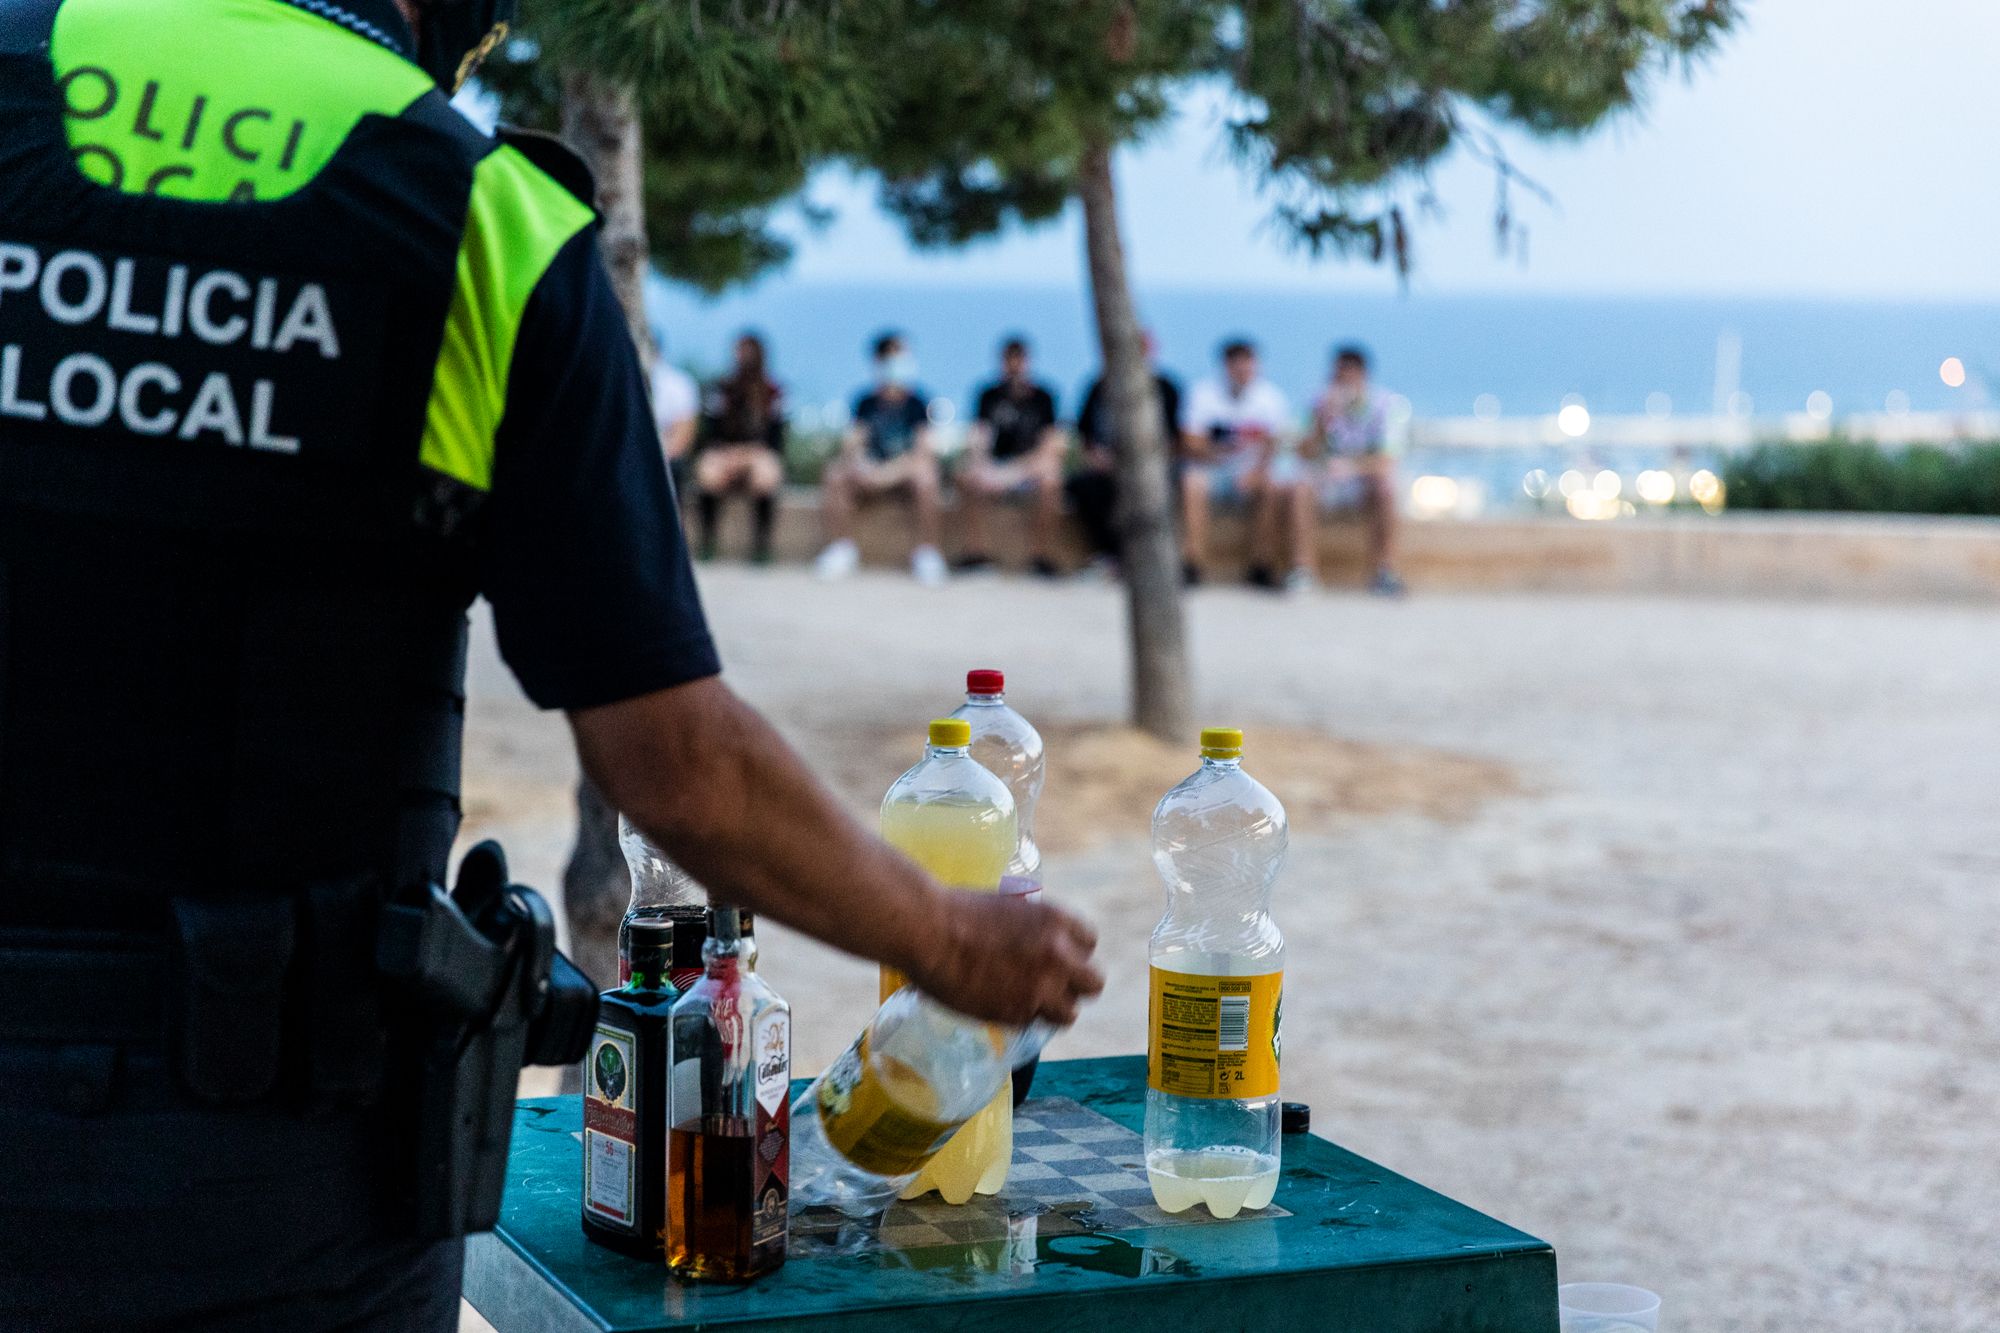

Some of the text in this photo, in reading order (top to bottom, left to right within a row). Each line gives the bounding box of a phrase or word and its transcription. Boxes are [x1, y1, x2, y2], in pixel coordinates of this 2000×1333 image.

[0, 243, 340, 359] POLICIA
[0, 344, 300, 456] LOCAL
[1234, 1070, 1245, 1080] 2L
